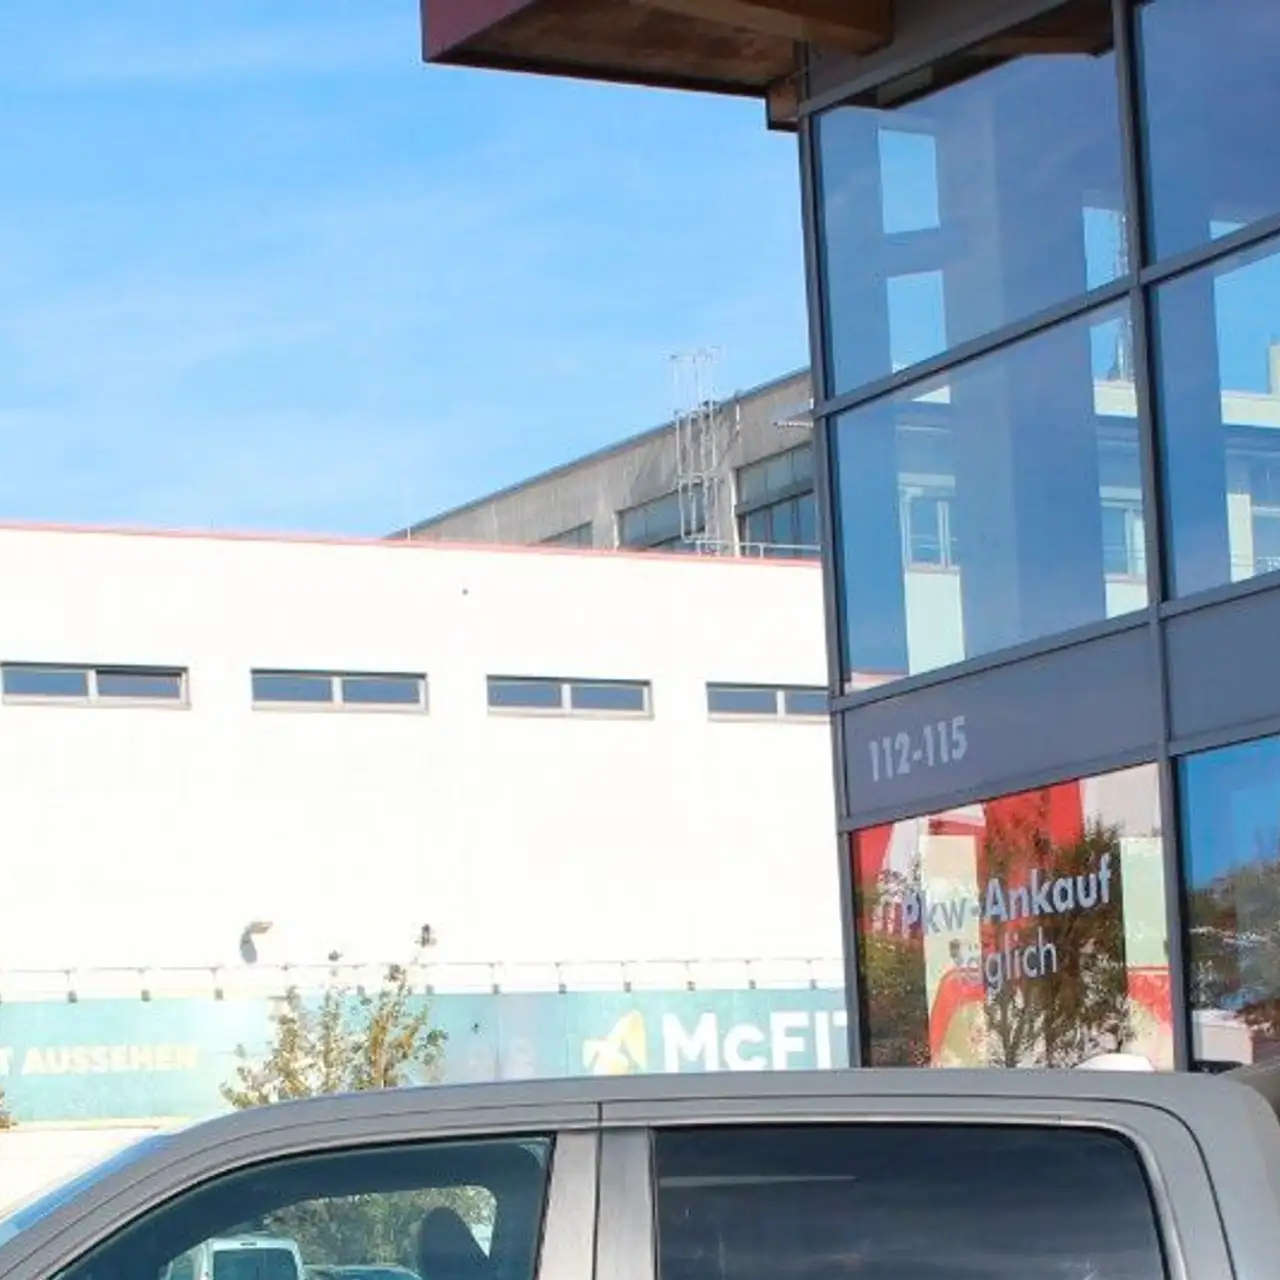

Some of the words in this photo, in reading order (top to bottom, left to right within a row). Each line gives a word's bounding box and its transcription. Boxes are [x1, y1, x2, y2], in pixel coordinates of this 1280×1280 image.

[868, 715, 968, 782] 112-115
[901, 853, 1112, 940] Pkw-Ankauf
[952, 926, 1058, 998] äglich
[22, 1045, 198, 1074] AUSSEHEN
